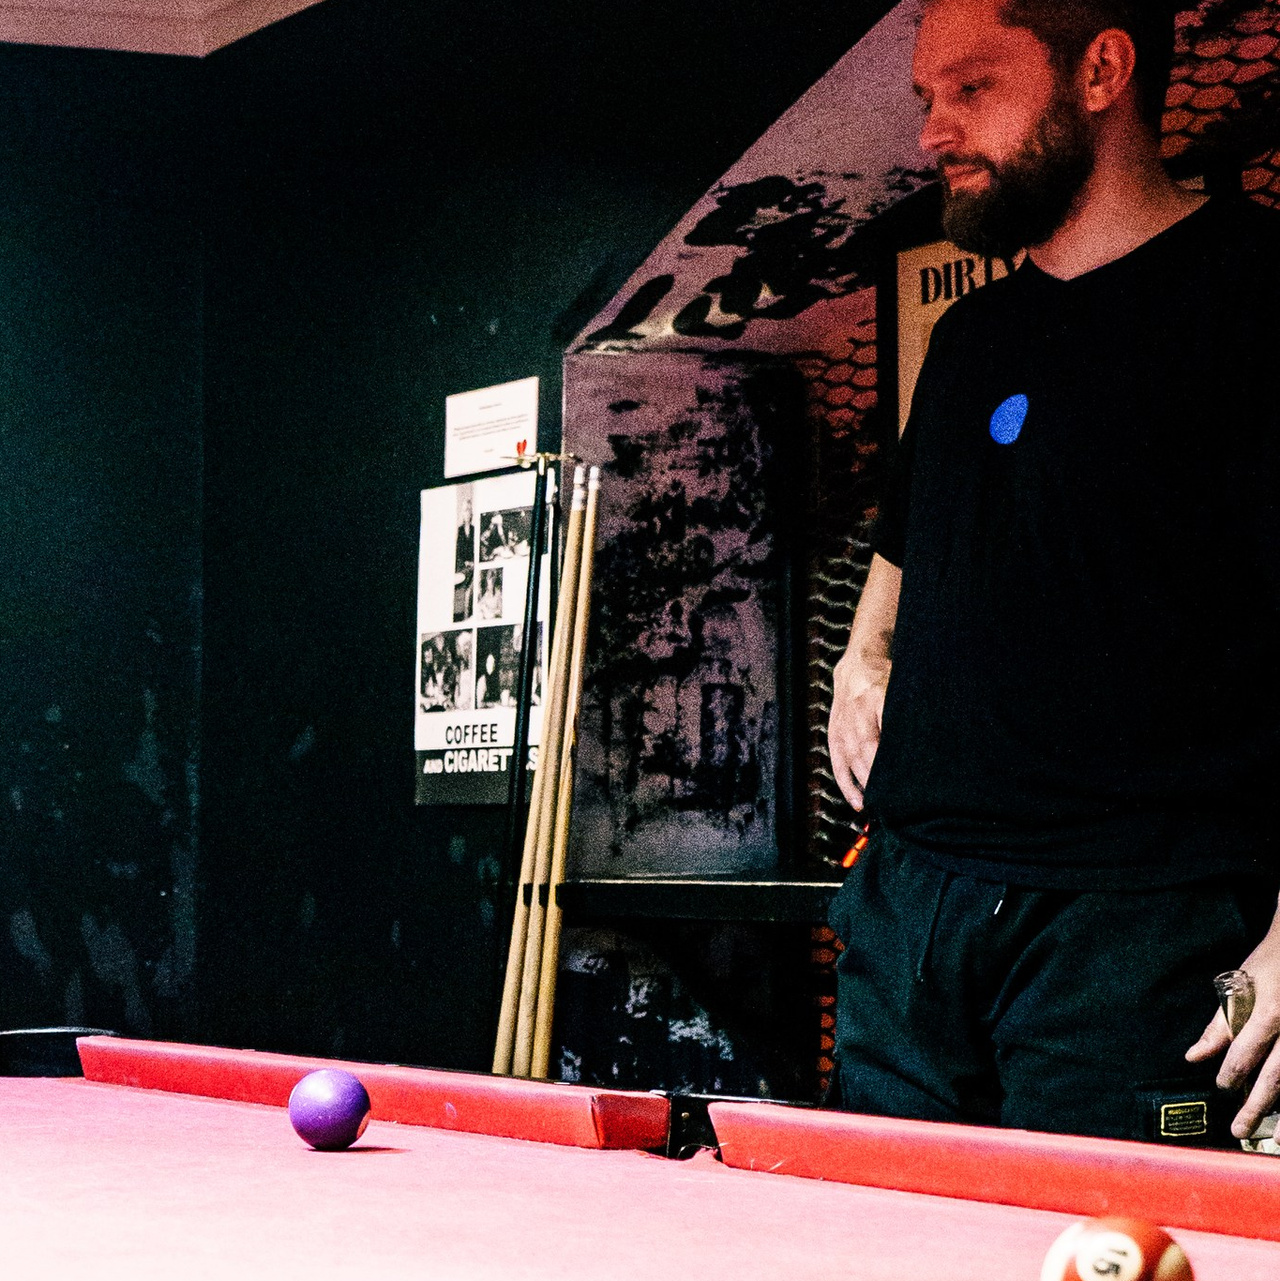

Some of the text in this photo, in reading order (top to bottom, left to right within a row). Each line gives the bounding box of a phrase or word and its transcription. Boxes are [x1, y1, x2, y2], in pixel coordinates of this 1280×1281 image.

[445, 723, 498, 744] COFFEE
[423, 748, 540, 774] AND CIGARETS
